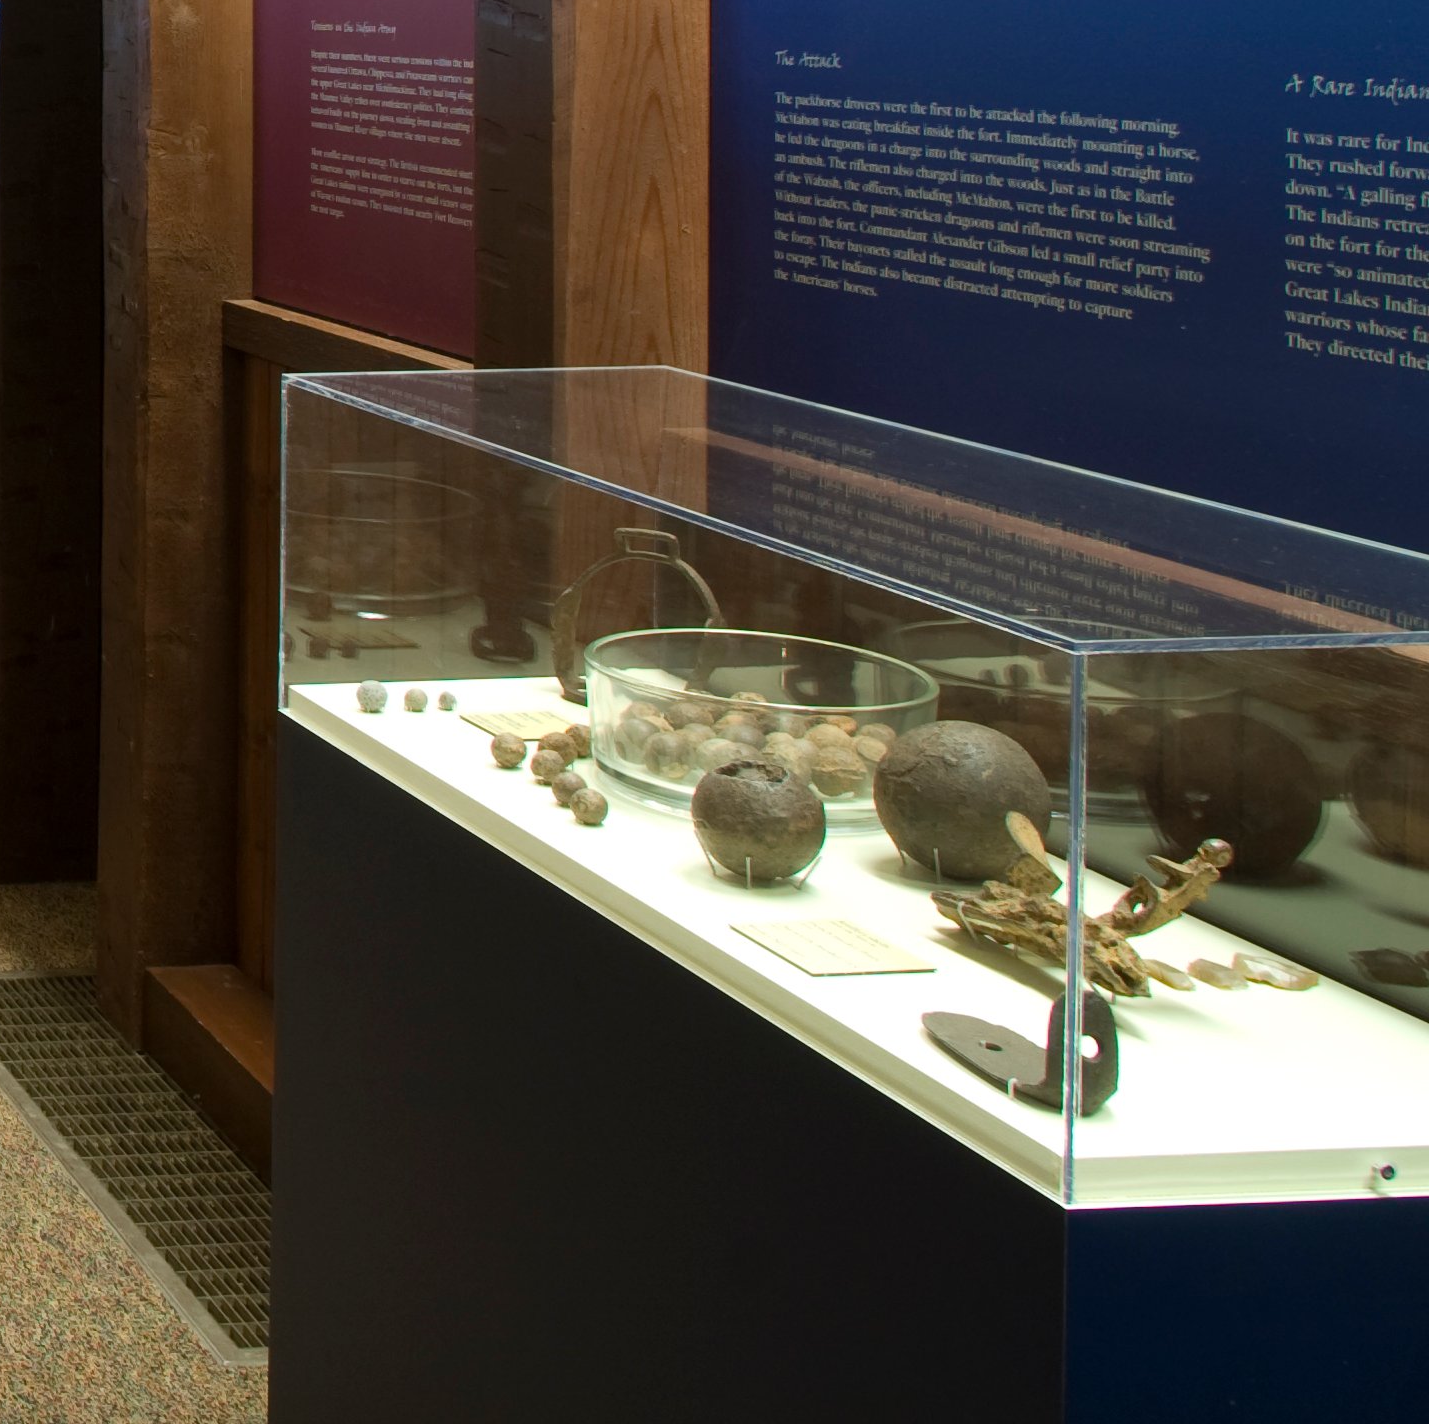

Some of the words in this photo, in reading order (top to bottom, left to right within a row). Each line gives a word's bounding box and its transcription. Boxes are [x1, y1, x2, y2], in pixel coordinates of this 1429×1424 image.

[774, 49, 795, 65] The
[798, 51, 843, 69] Attack
[1284, 73, 1305, 94] A
[1308, 74, 1357, 99] Rare
[775, 91, 793, 105] The
[794, 93, 842, 109] packhorse
[843, 96, 881, 111] drovers
[883, 102, 907, 114] were
[909, 101, 927, 115] the
[929, 101, 952, 117] first
[954, 106, 967, 118] to
[969, 104, 983, 119] be
[985, 107, 1035, 123] attacked
[1037, 109, 1057, 125] the
[1059, 110, 1118, 134] following
[1120, 118, 1179, 138] morning.
[821, 117, 840, 128] was
[841, 119, 872, 135] eating
[873, 119, 920, 136] breakfast
[923, 123, 954, 139] inside
[957, 127, 975, 141] the
[977, 127, 1000, 143] fort.
[1006, 130, 1077, 154] Immediately
[1082, 139, 1144, 160] mounting
[1146, 144, 1155, 156] a
[1158, 142, 1199, 161] horse,
[1286, 127, 1299, 144] It
[1303, 132, 1333, 146] was
[1337, 135, 1370, 149] rare
[1375, 133, 1400, 151] for
[774, 131, 785, 143] he
[787, 132, 802, 145] led
[804, 134, 819, 147] the
[821, 135, 864, 153] dragoons
[867, 139, 878, 152] in
[879, 143, 886, 153] a
[888, 141, 922, 160] charge
[925, 144, 947, 159] into
[949, 147, 966, 162] the
[969, 152, 1039, 173] surrounding
[1043, 157, 1081, 173] woods
[1084, 160, 1108, 176] and
[1111, 164, 1161, 184] straight
[1165, 167, 1193, 184] into
[1285, 153, 1323, 176] They
[1329, 158, 1385, 177] rushed
[1007, 176, 1046, 192] woods.
[1049, 179, 1074, 195] Just
[1077, 185, 1091, 197] as
[1093, 183, 1107, 199] in
[1110, 185, 1131, 202] the
[1135, 188, 1174, 207] Battle
[1284, 178, 1332, 198] down.
[1360, 186, 1416, 211] galling
[1286, 204, 1316, 222] The
[1321, 207, 1380, 229] Indians
[1284, 233, 1305, 247] on
[1309, 233, 1335, 251] the
[1339, 235, 1370, 255] fort
[1375, 239, 1400, 258] for
[1285, 259, 1322, 275] were
[1284, 280, 1329, 302] Great
[1333, 287, 1379, 309] Lakes
[1284, 310, 1351, 331] warriors
[1355, 319, 1408, 340] whose
[1286, 331, 1322, 357] They
[1327, 339, 1395, 365] directed
